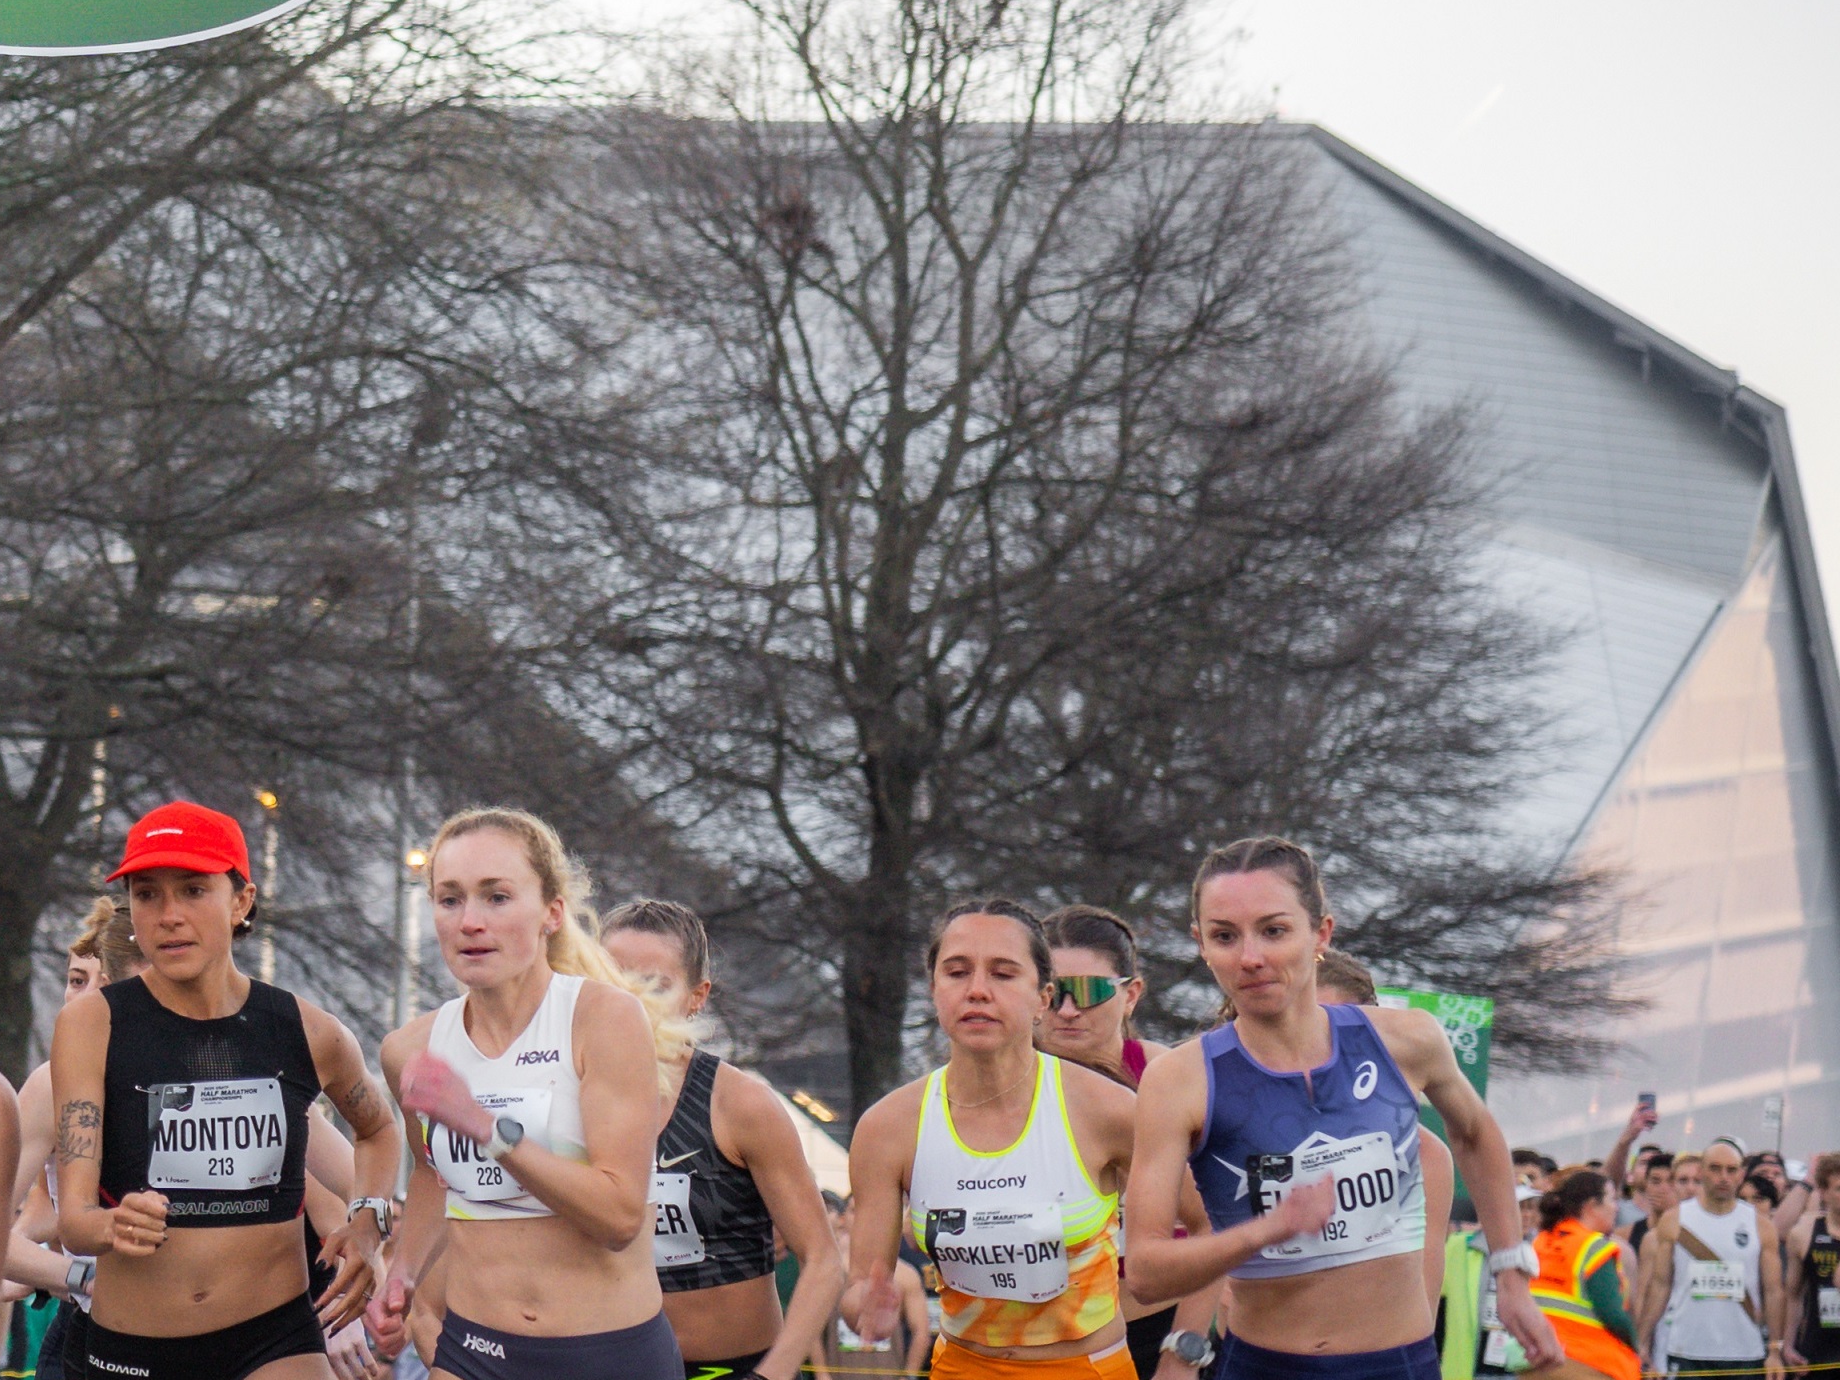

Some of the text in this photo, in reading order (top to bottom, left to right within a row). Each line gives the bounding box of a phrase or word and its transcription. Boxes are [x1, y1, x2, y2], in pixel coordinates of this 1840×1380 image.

[515, 1050, 560, 1067] HOKA
[221, 1088, 258, 1096] MARATHON
[155, 1113, 283, 1152] MONTOYA
[1322, 1145, 1363, 1161] MARATHON
[208, 1157, 234, 1176] 213
[476, 1166, 503, 1186] 228
[956, 1175, 1027, 1191] saucony
[169, 1199, 269, 1216] SALOMON
[992, 1213, 1033, 1221] MARATHON
[1320, 1219, 1349, 1242] 192
[934, 1240, 1061, 1266] GOCKLEY-DAY
[989, 1272, 1017, 1289] 195
[462, 1332, 506, 1360] HOKA
[88, 1354, 150, 1377] SALOMON
